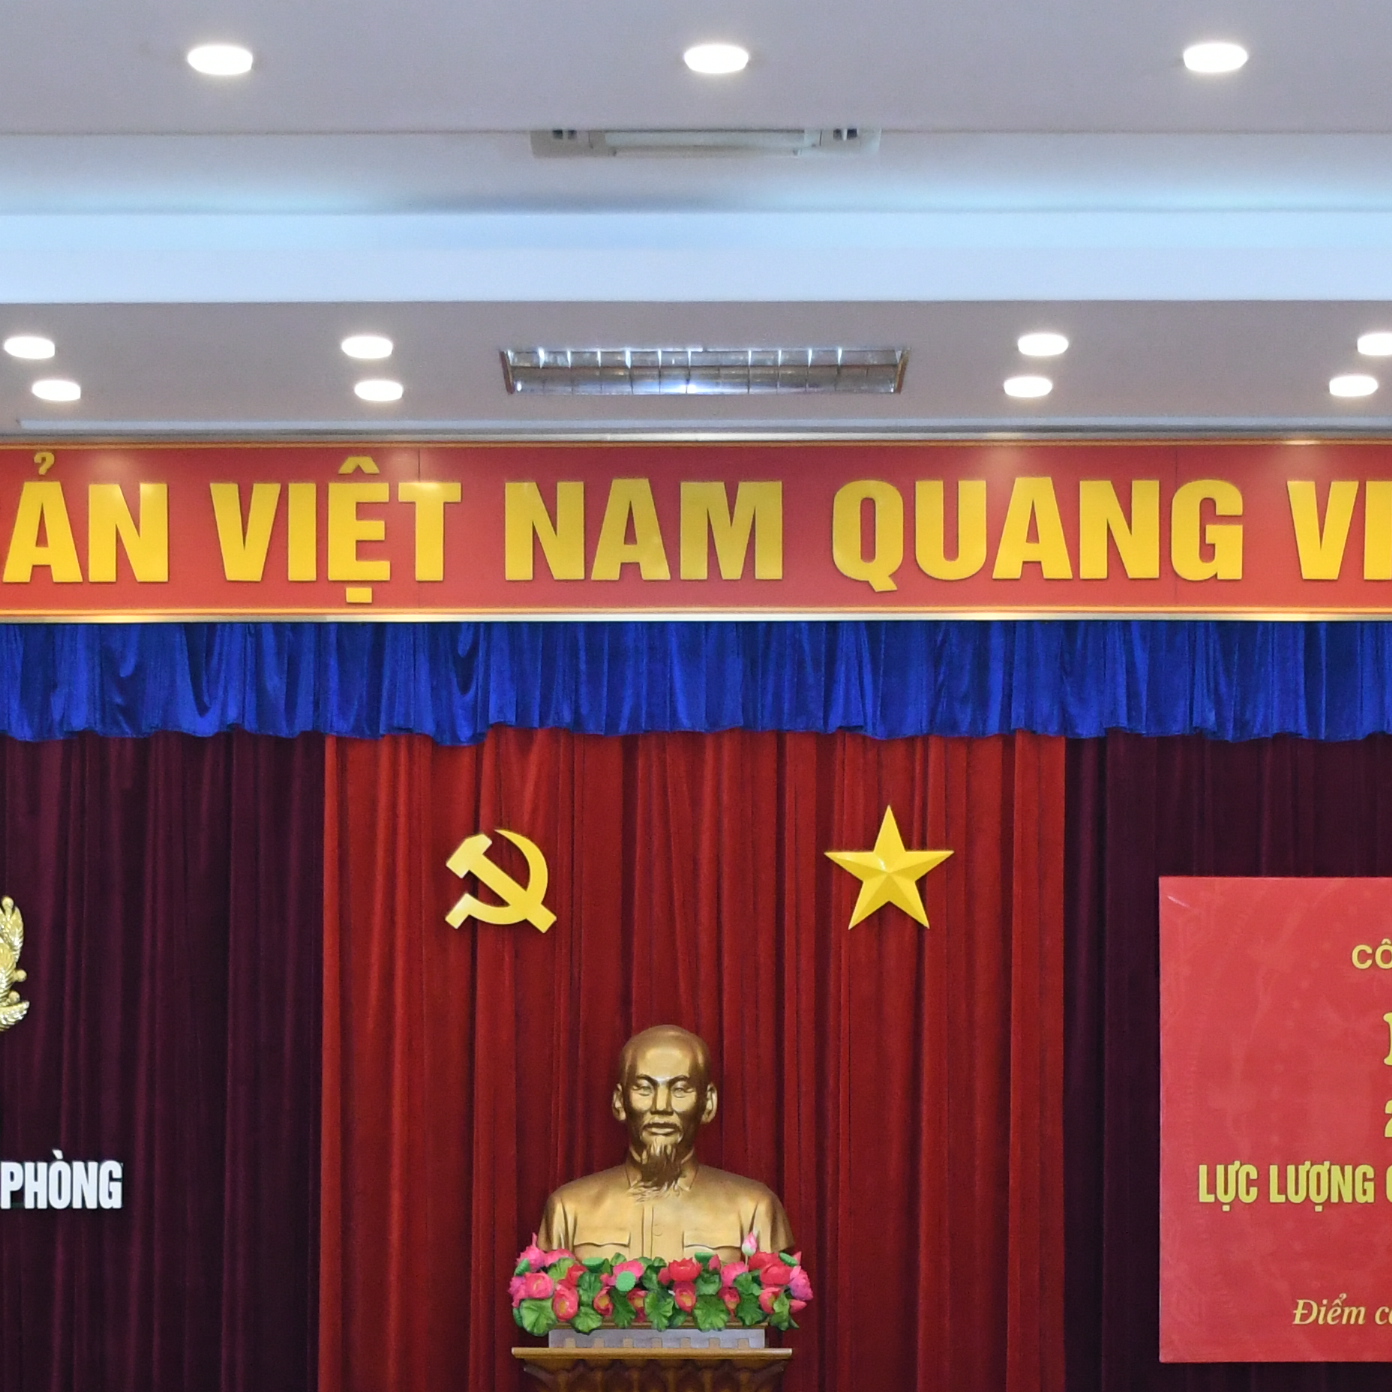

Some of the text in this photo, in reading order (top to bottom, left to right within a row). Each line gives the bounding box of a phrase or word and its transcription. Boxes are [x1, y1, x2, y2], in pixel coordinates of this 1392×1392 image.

[210, 455, 461, 605] VIỆT
[503, 478, 784, 583] NAM
[830, 476, 1246, 596] QUANG
[0, 1149, 123, 1210] PHÒNG
[1198, 1160, 1258, 1212] LỰC
[1269, 1160, 1375, 1212] LƯỢNG
[1292, 1292, 1366, 1325] Điểm
